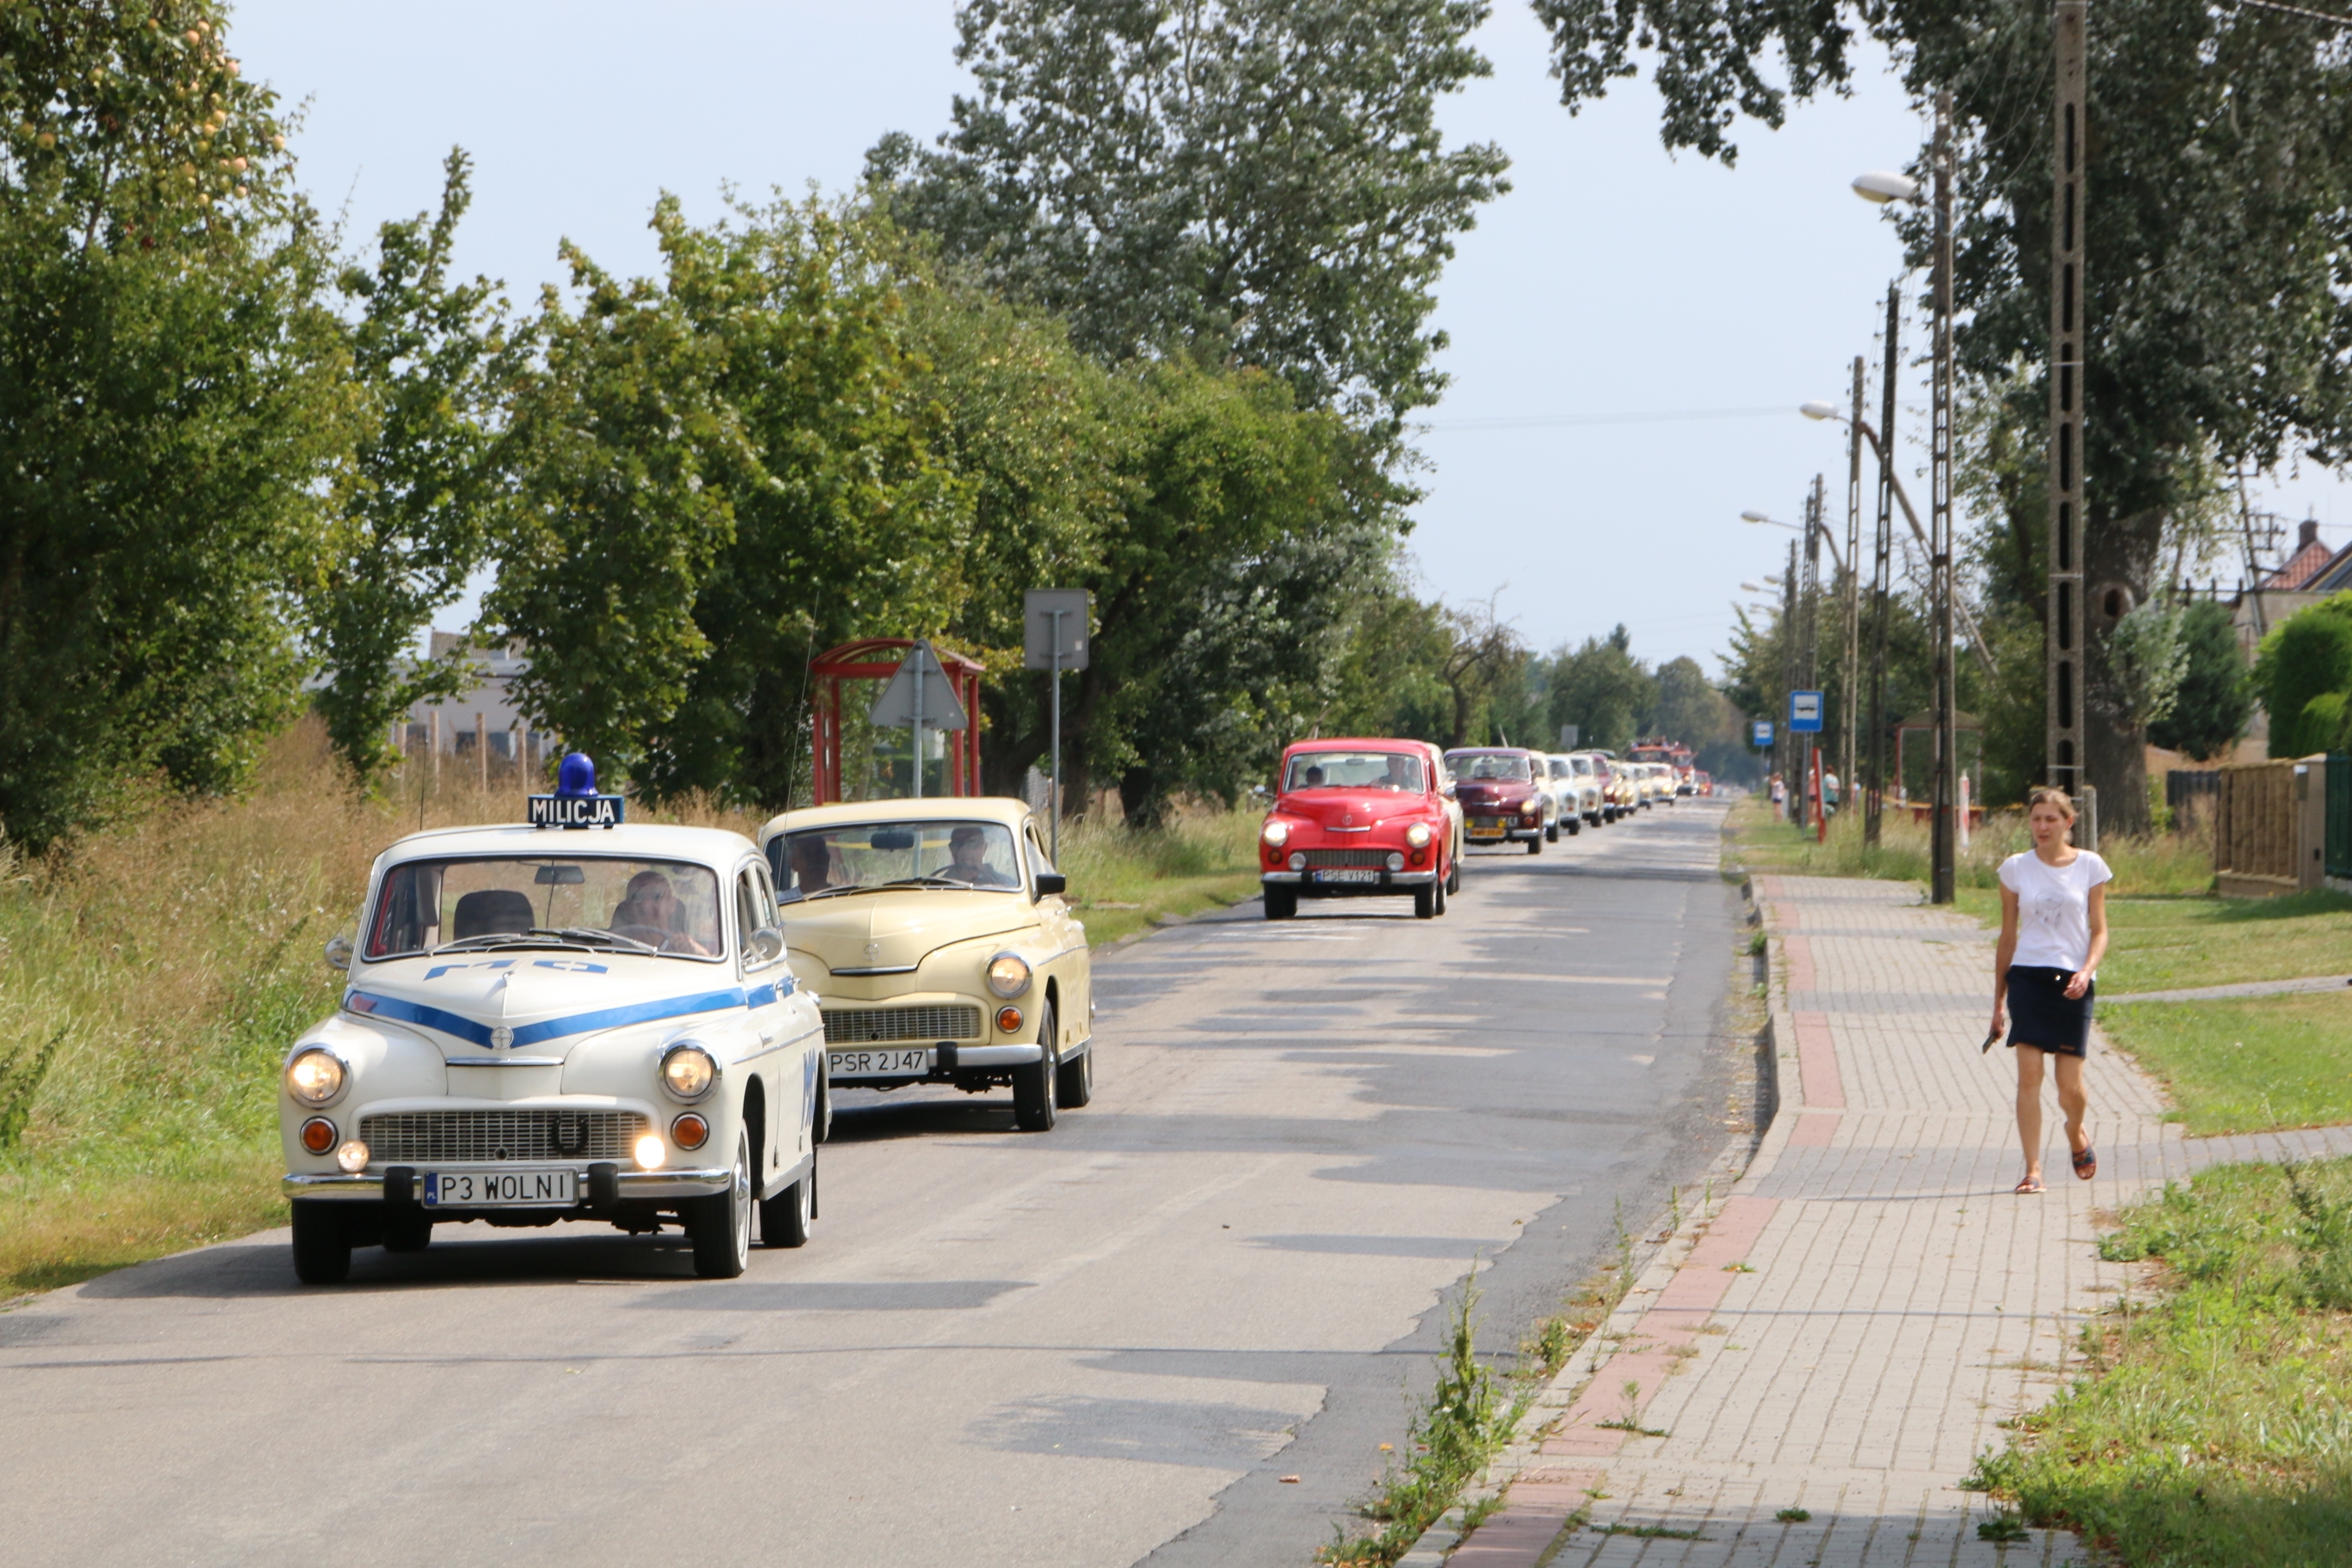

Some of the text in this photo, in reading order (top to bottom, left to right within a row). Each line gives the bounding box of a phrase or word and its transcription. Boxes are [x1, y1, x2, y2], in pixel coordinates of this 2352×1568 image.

[532, 799, 616, 824] MILICJA
[1348, 870, 1371, 882] V121
[830, 1050, 924, 1073] PSR 2J47
[442, 1173, 564, 1201] P3 WOLNI
